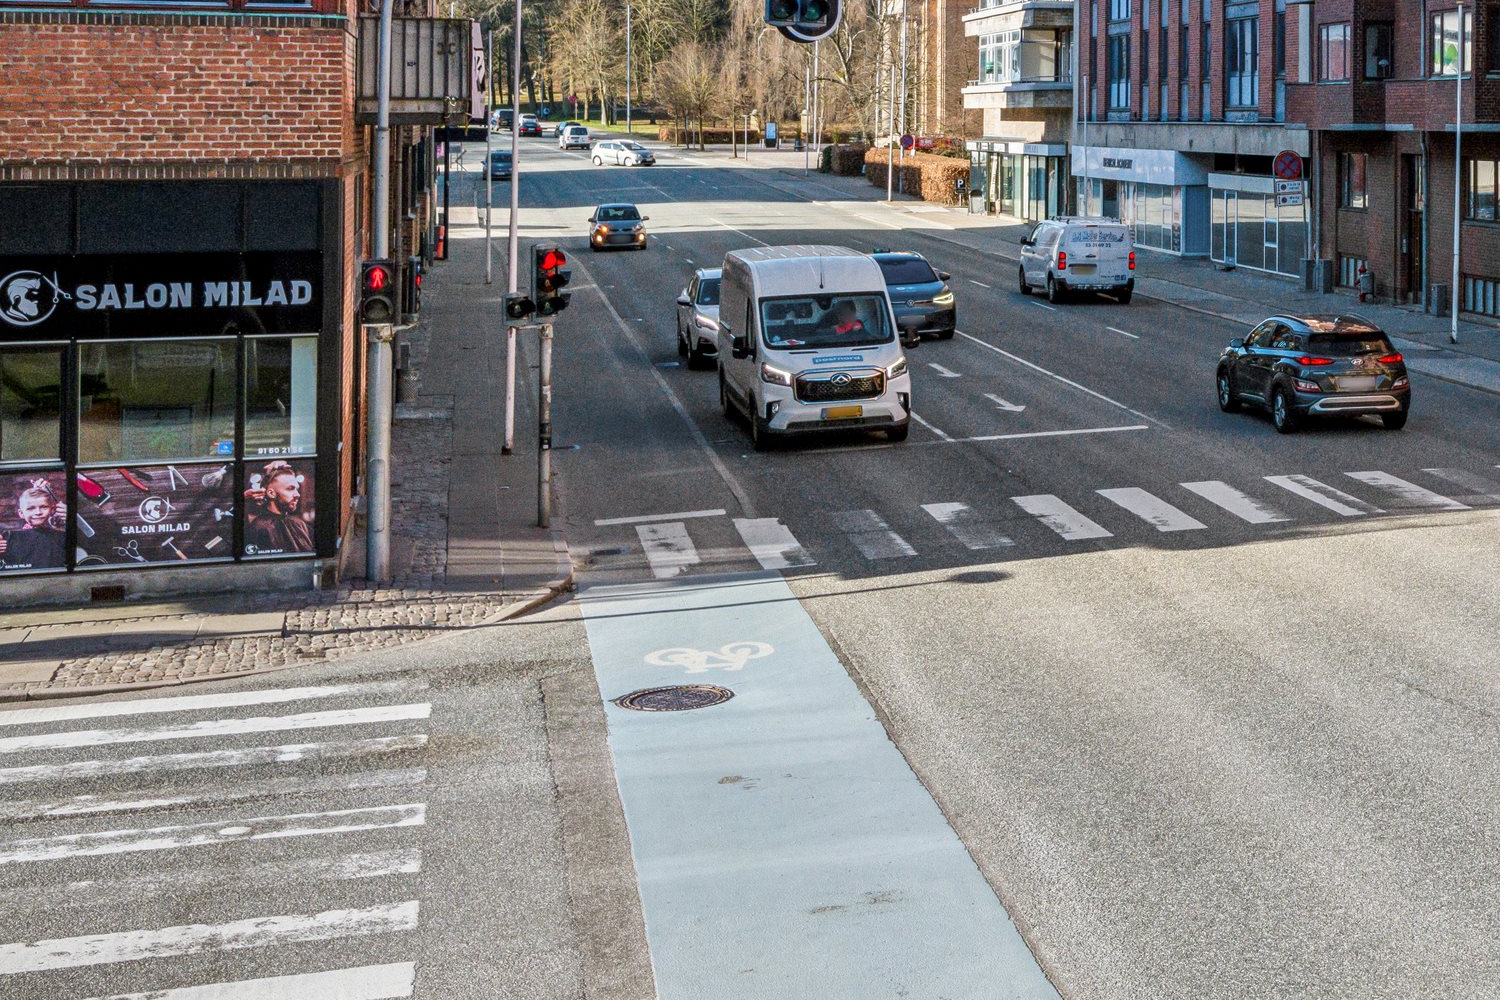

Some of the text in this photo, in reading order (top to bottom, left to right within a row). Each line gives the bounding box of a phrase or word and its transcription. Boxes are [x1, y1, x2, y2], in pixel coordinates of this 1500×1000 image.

[957, 179, 964, 188] P
[75, 280, 312, 309] SALON MILAD
[121, 522, 190, 534] SALON MILAD
